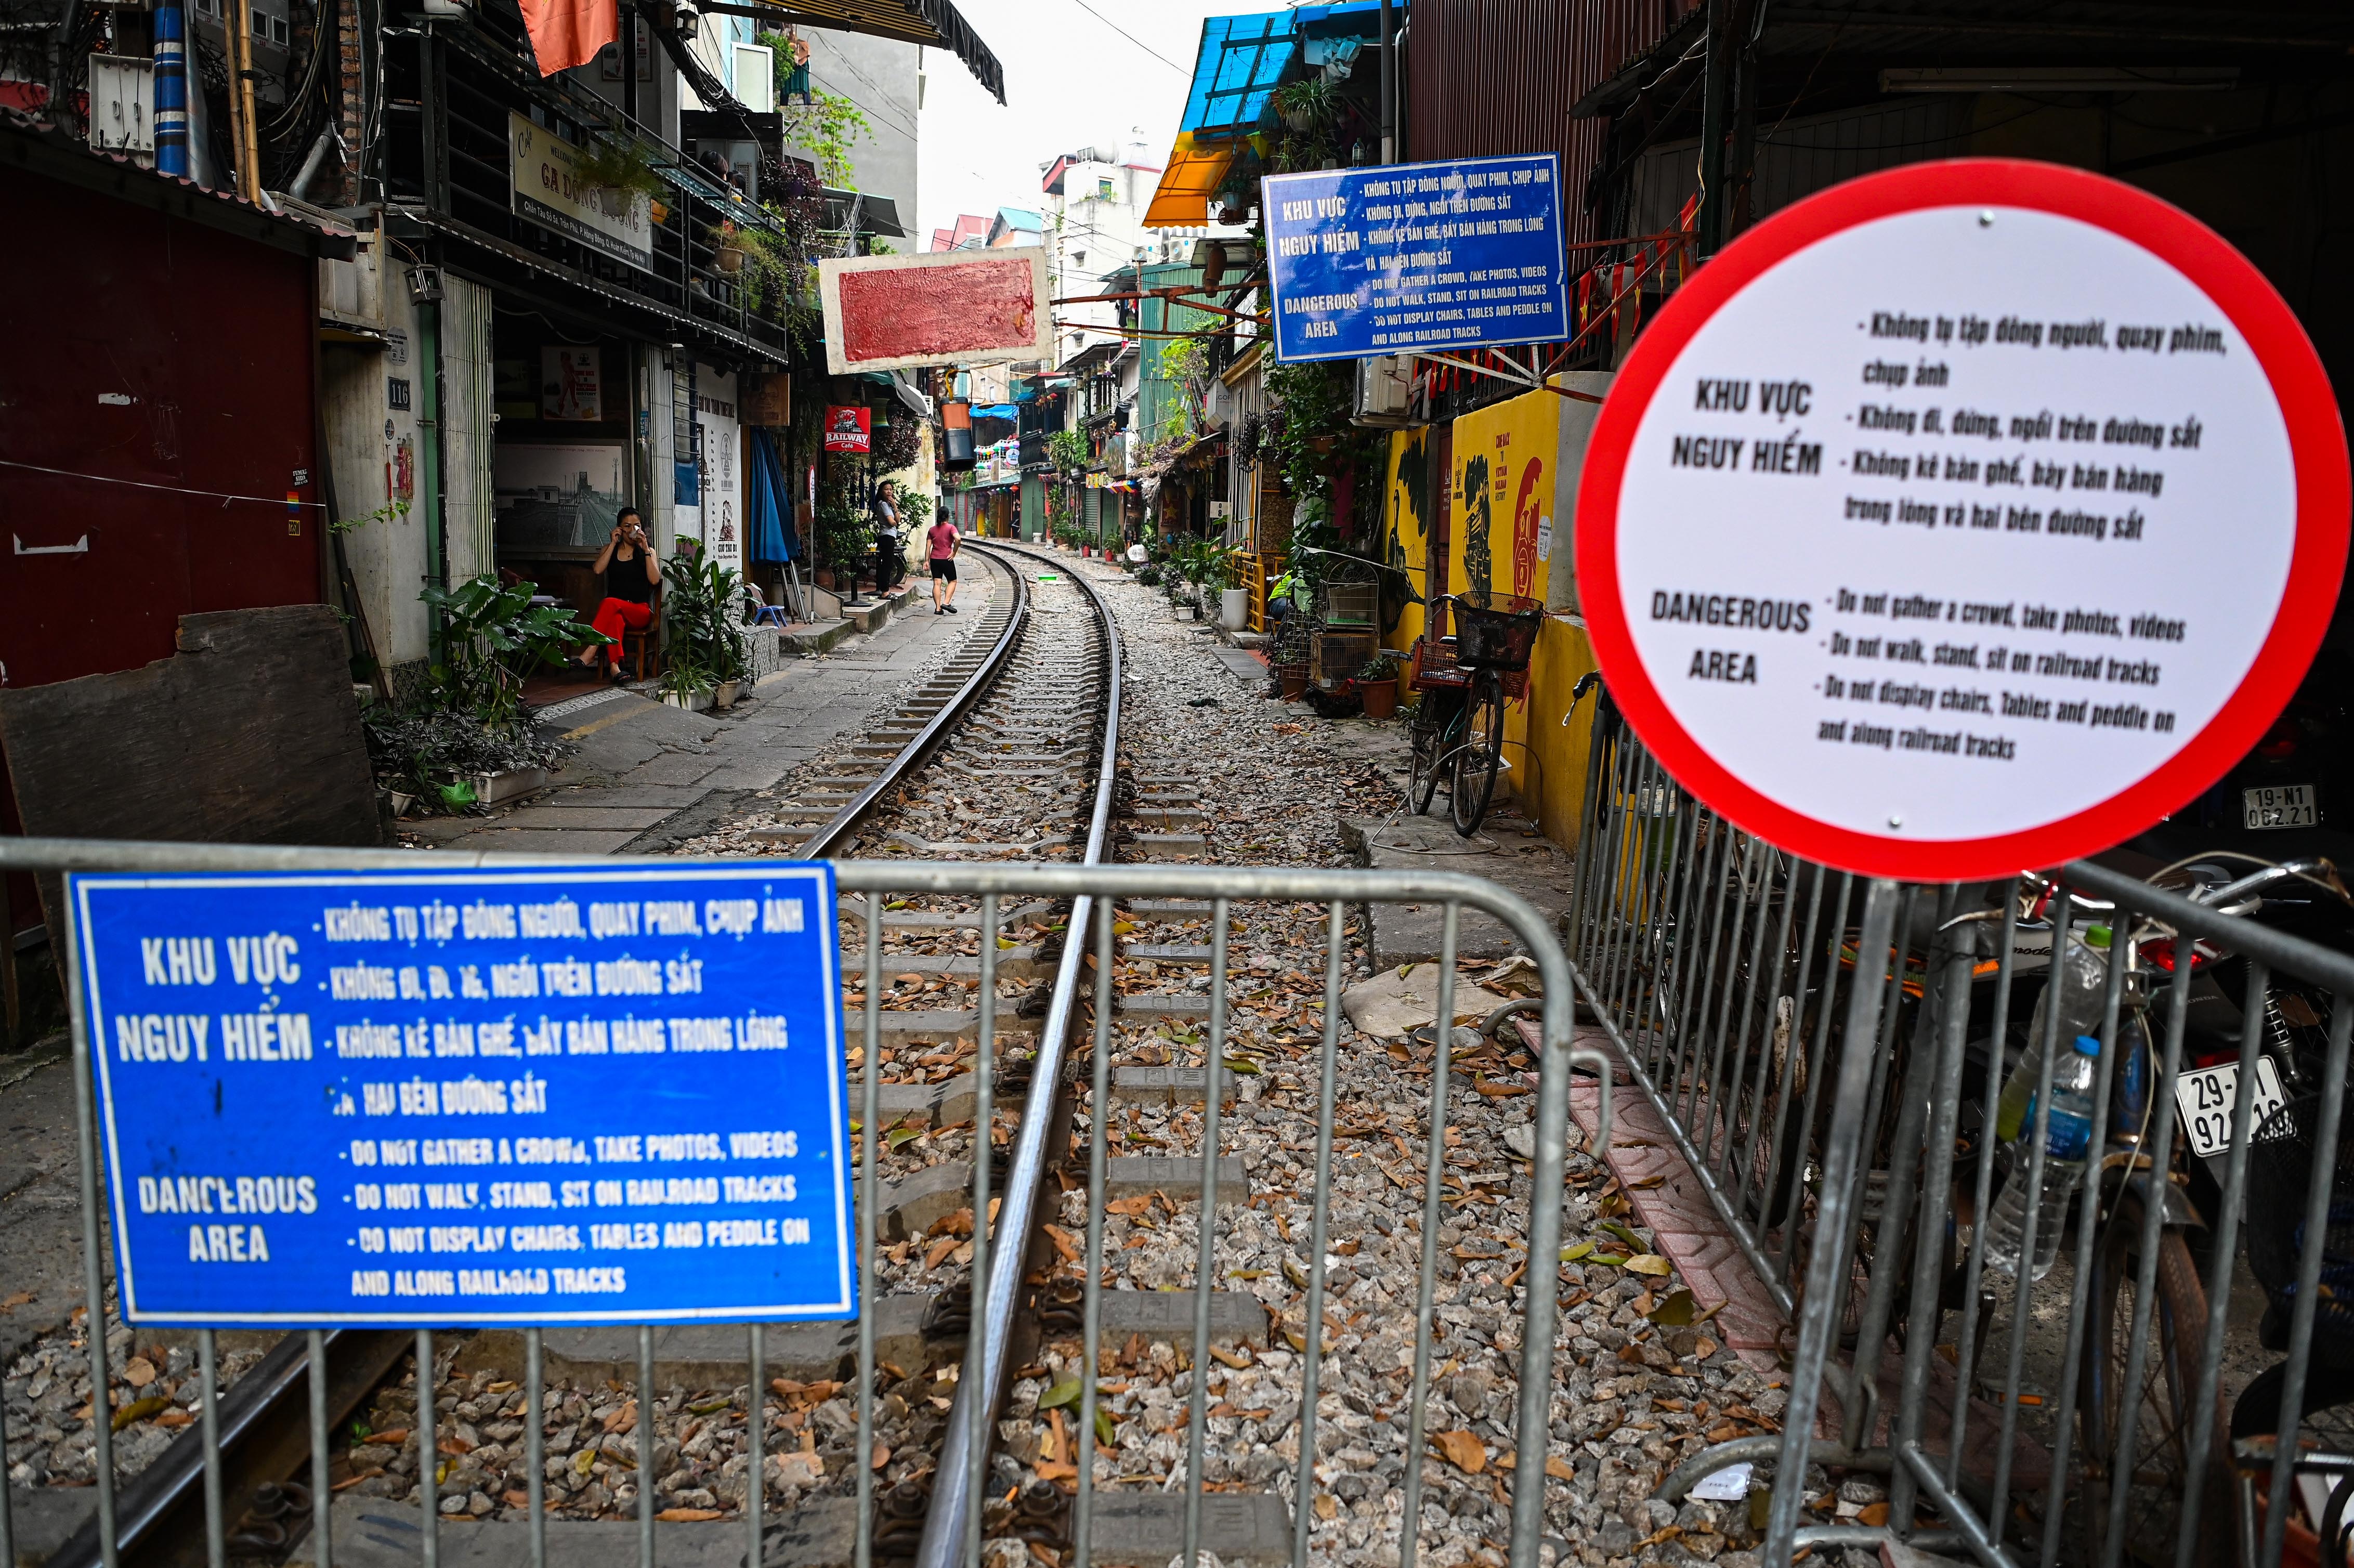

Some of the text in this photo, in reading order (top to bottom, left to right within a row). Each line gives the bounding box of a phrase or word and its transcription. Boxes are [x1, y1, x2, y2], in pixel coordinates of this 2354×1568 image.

[518, 125, 532, 158] Café
[541, 162, 559, 194] GA
[1364, 180, 1390, 197] KHÔNG
[1391, 181, 1401, 198] TỤ
[1403, 177, 1417, 197] TẬP
[1418, 176, 1439, 192] ĐÔNG
[1468, 173, 1487, 189] QUAY
[1489, 172, 1510, 187] PHIM,
[1513, 170, 1532, 187] CHỤP
[1534, 163, 1549, 183] ẢNH
[1283, 195, 1346, 221] KHU VỰC
[1366, 204, 1392, 221] KHÔNG
[1393, 205, 1404, 219] ĐI,
[1405, 200, 1428, 218] ĐỨNG,
[1470, 194, 1496, 212] ĐƯỜNG
[1497, 191, 1511, 210] SẮT
[1279, 224, 1359, 257] NGUY HIỂM
[1368, 228, 1394, 244] KHÔNG
[1407, 224, 1423, 241] BÀN
[1424, 220, 1442, 240] GHẾ,
[1459, 220, 1475, 237] BÁN
[1476, 218, 1497, 236] HÀNG
[1498, 218, 1523, 234] TRONG
[1524, 214, 1544, 232] LÒNG
[1366, 254, 1376, 271] VÀ
[1410, 250, 1436, 268] ĐƯỜNG
[1437, 246, 1451, 266] SẮT
[1372, 266, 1547, 290] DO NOT GATHER A CROWD, TAKE PHOTOS, VIDEOS
[1284, 293, 1358, 314] DANGEROUS
[1374, 284, 1547, 308] DO NOT WALK, STAND, SIT ON RAILROAD TRACKS
[1305, 320, 1338, 338] AREA
[1374, 302, 1552, 327] DO NOT DISPLAY CHAIRS, TABLES AND PEDDLE ON
[1372, 325, 1481, 345] AND ALONG RAILROAD TRACKS
[392, 383, 408, 404] 116
[1694, 378, 1751, 412] KHU
[826, 433, 868, 444] RAILWAY
[1671, 435, 1745, 471] NGUY
[1651, 590, 1812, 634] DANGEROUS
[1947, 602, 1957, 622] a
[2022, 602, 2059, 631] take
[2062, 606, 2123, 641] photos,
[2130, 611, 2187, 643] videos
[1689, 648, 1758, 684] AREA
[2256, 787, 2303, 807] 19-N1
[141, 931, 301, 994] KHU VỰC
[2187, 995, 2219, 1004] ONDA
[115, 995, 313, 1062] NGUY HIỂM
[2190, 1068, 2266, 1110] 29-1
[351, 1139, 377, 1166] DO
[381, 1139, 417, 1166] NOT
[422, 1138, 494, 1166] GATHER
[498, 1138, 512, 1165] A
[594, 1135, 643, 1162] TAKE
[729, 1130, 799, 1159] VIDEOS
[189, 1224, 269, 1262] AREA
[388, 1227, 425, 1253] NOT
[590, 1222, 659, 1250] TABLES
[663, 1221, 703, 1248] AND
[706, 1219, 778, 1247] PEDDLE
[781, 1218, 810, 1245] ON
